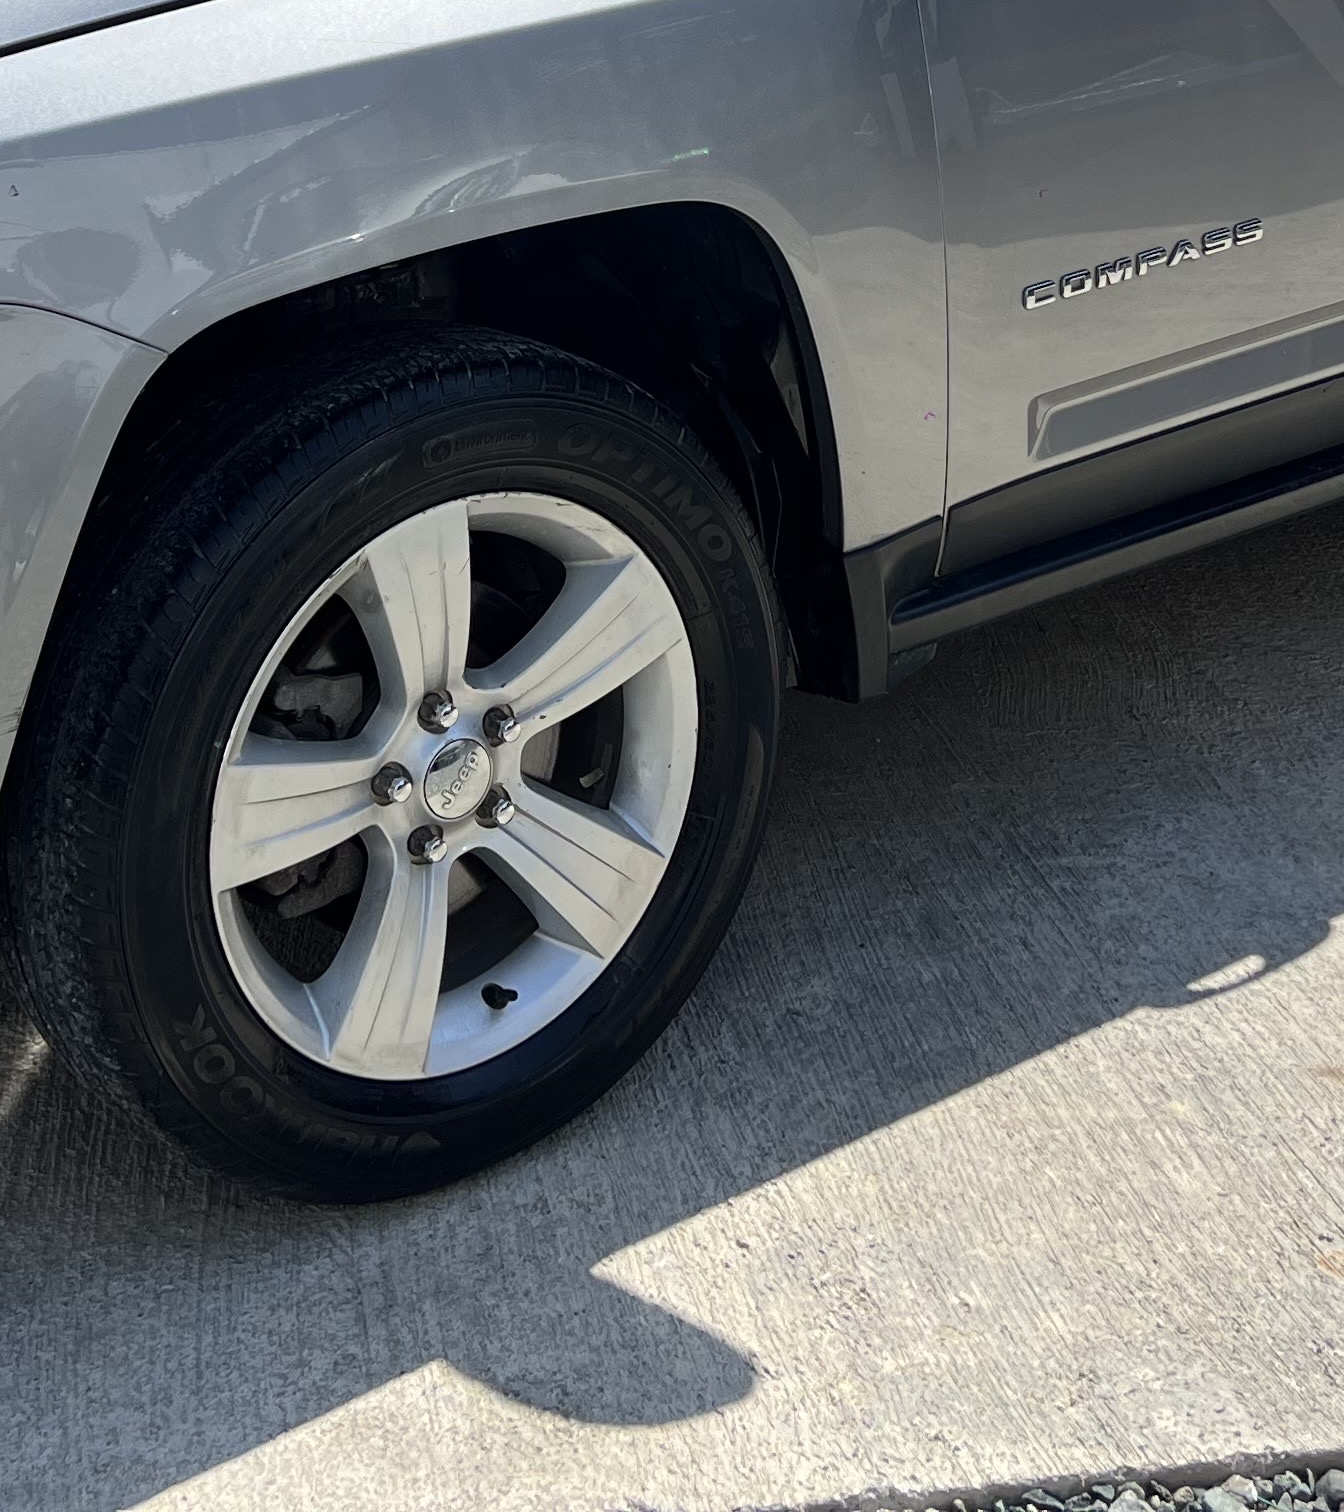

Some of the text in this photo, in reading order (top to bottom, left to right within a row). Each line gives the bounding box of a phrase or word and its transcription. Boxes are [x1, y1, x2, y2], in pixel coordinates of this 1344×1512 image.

[1022, 217, 1264, 310] COMPASS
[557, 423, 733, 562] OPTIMO
[441, 751, 479, 810] Jeep
